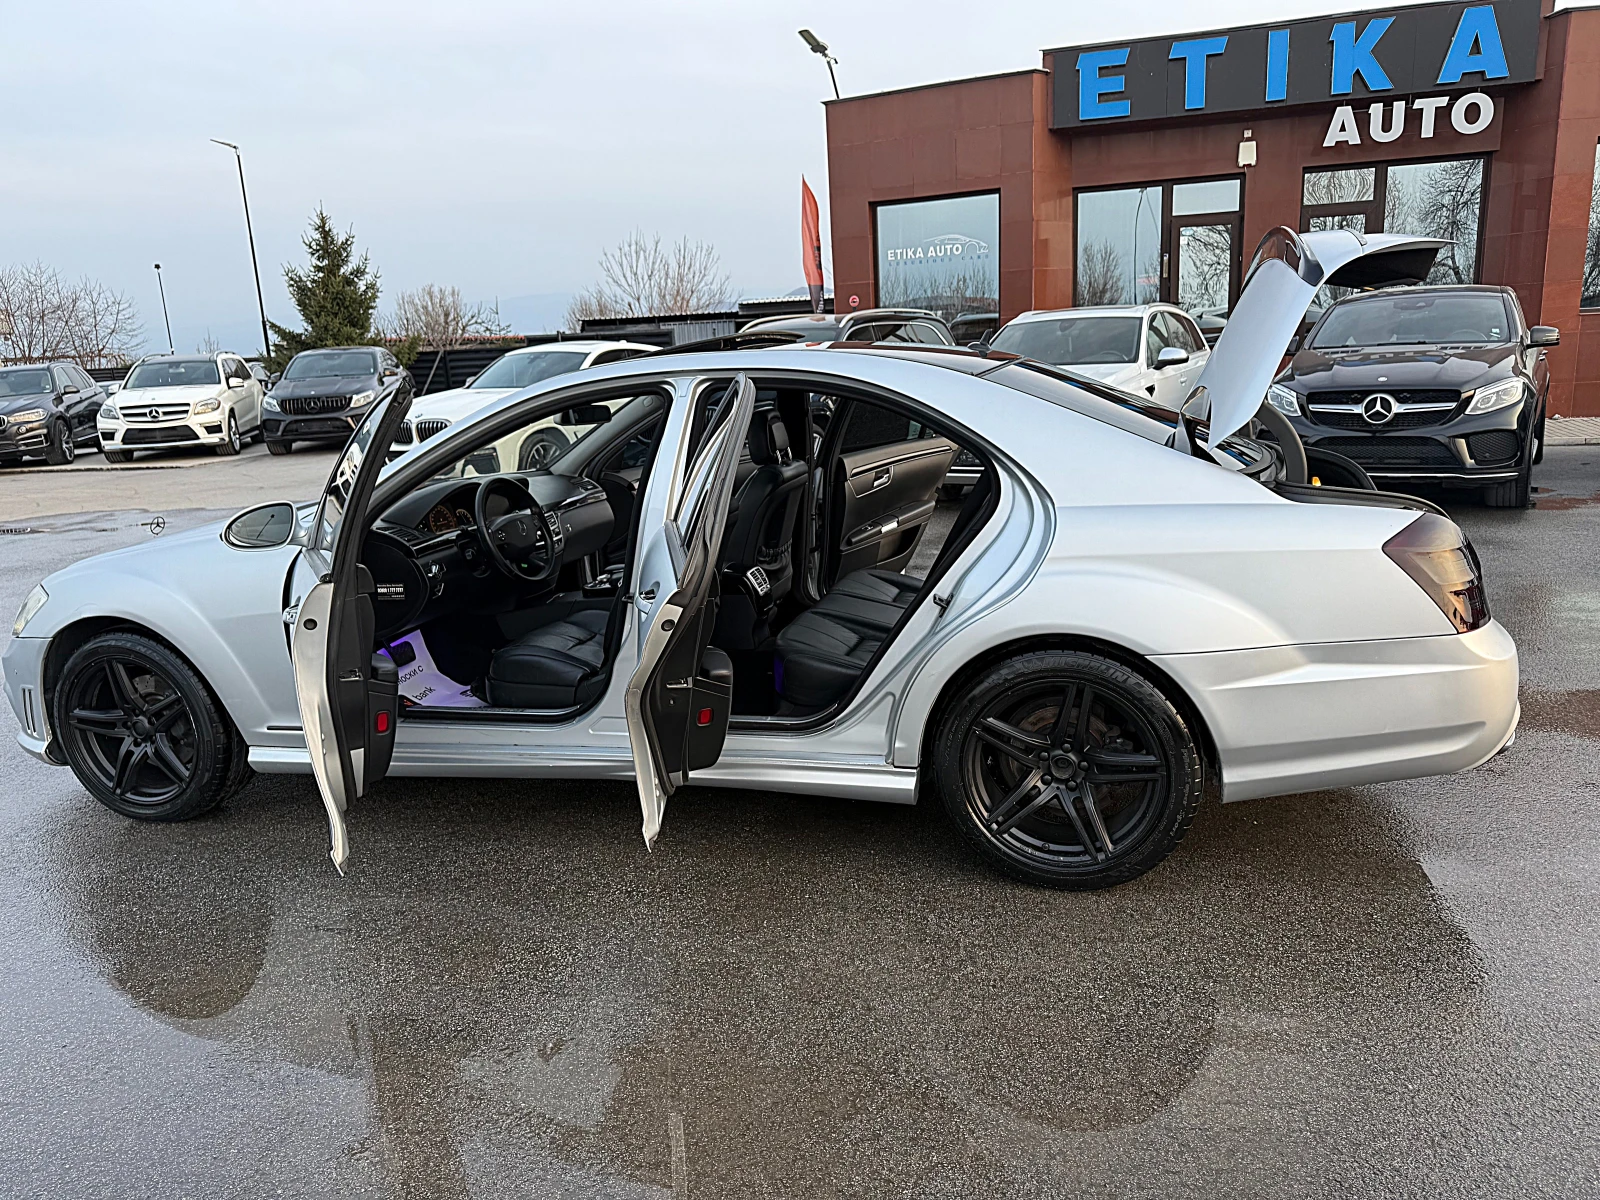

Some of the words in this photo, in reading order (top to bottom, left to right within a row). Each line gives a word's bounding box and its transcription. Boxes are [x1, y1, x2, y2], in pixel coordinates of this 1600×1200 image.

[1076, 4, 1510, 121] ETIKA
[1322, 92, 1495, 148] AUTO
[887, 247, 924, 261] ETIKA
[928, 243, 963, 257] AUTO
[1043, 656, 1131, 684] MICHELIN
[411, 686, 436, 701] bank
